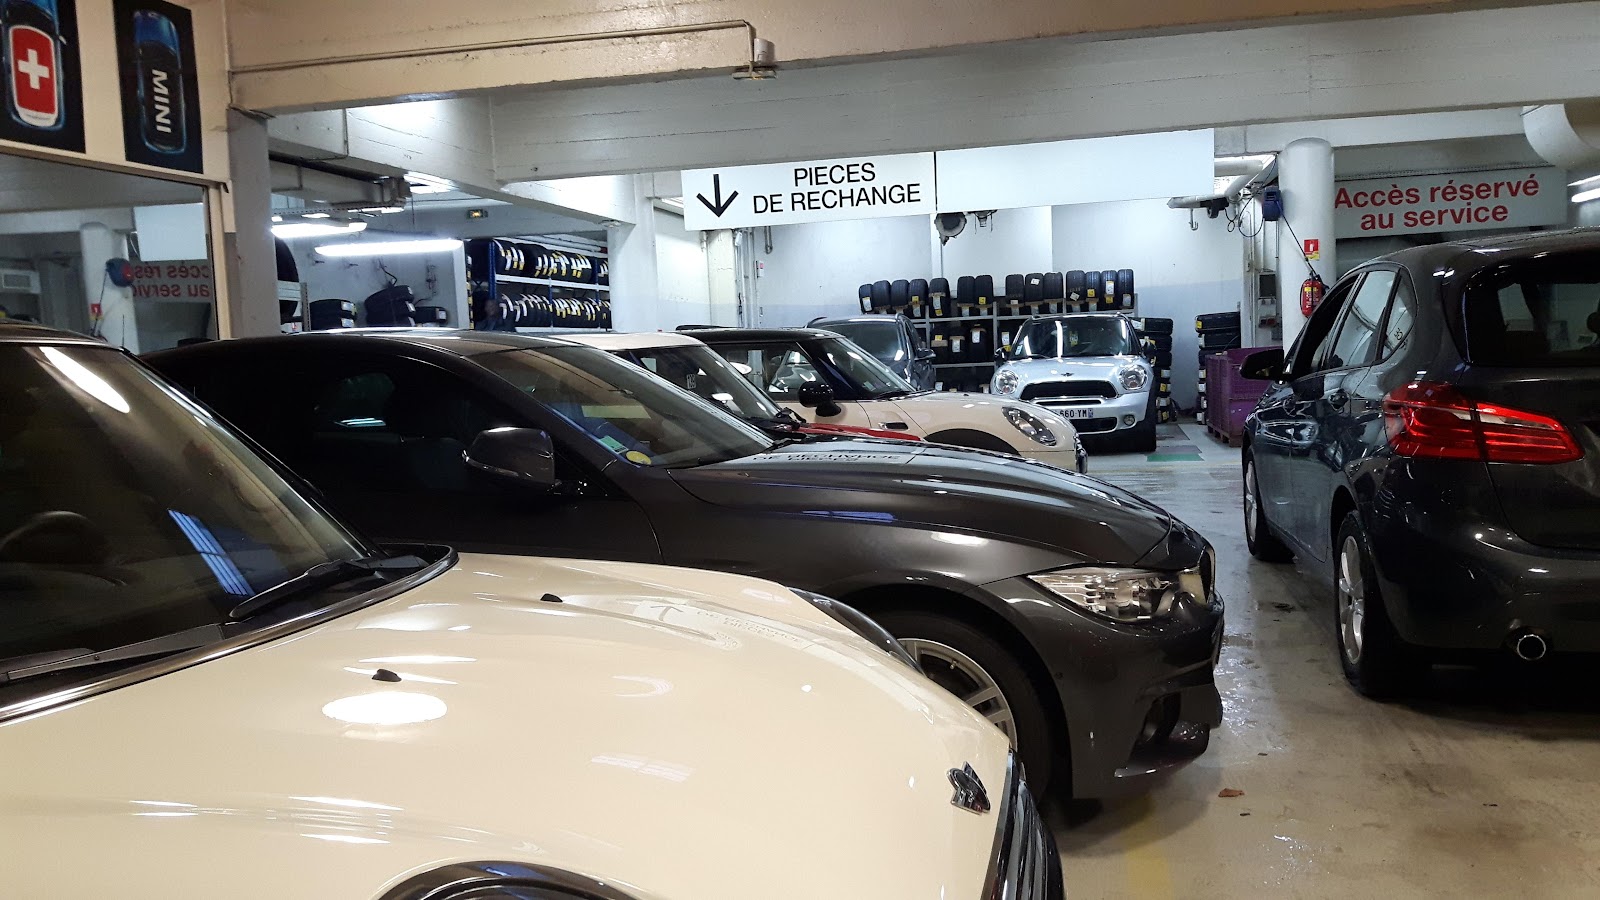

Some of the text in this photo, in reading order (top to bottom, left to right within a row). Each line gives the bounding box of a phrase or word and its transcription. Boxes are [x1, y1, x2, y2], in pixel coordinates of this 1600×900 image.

[152, 68, 171, 133] MINI
[794, 162, 876, 187] PIECES
[753, 183, 921, 213] DE RECHANGE
[1334, 173, 1539, 209] Accès réservé
[1360, 202, 1508, 231] au service
